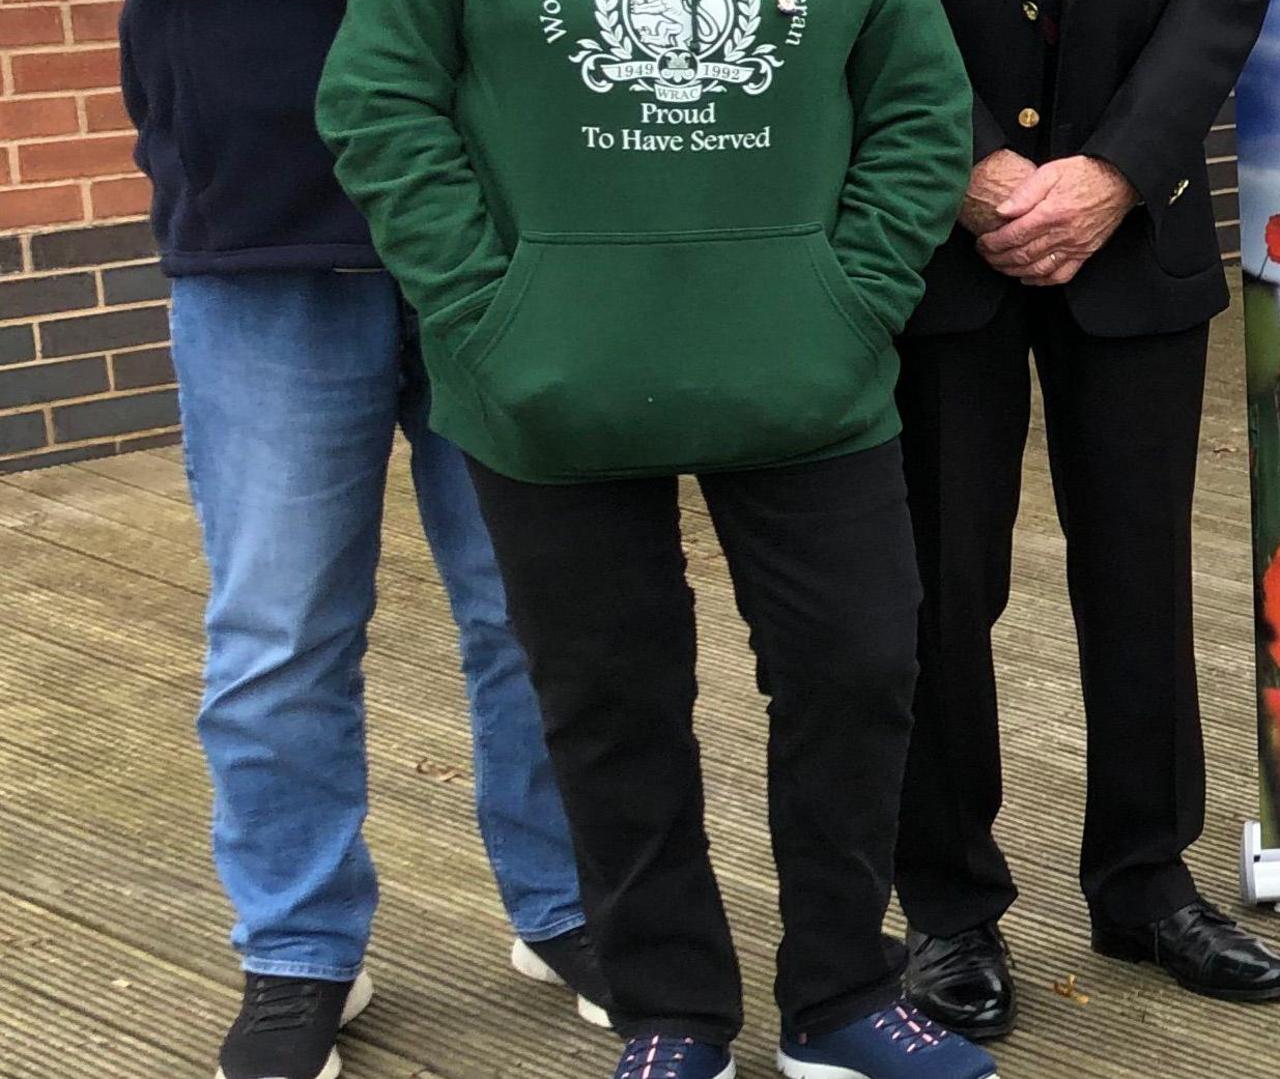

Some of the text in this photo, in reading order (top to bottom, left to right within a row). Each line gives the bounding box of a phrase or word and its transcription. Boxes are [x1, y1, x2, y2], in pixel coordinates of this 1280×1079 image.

[616, 63, 741, 81] 1949 1992
[657, 87, 699, 101] WRAC
[640, 102, 716, 124] Proud
[582, 126, 771, 152] To Have Served
